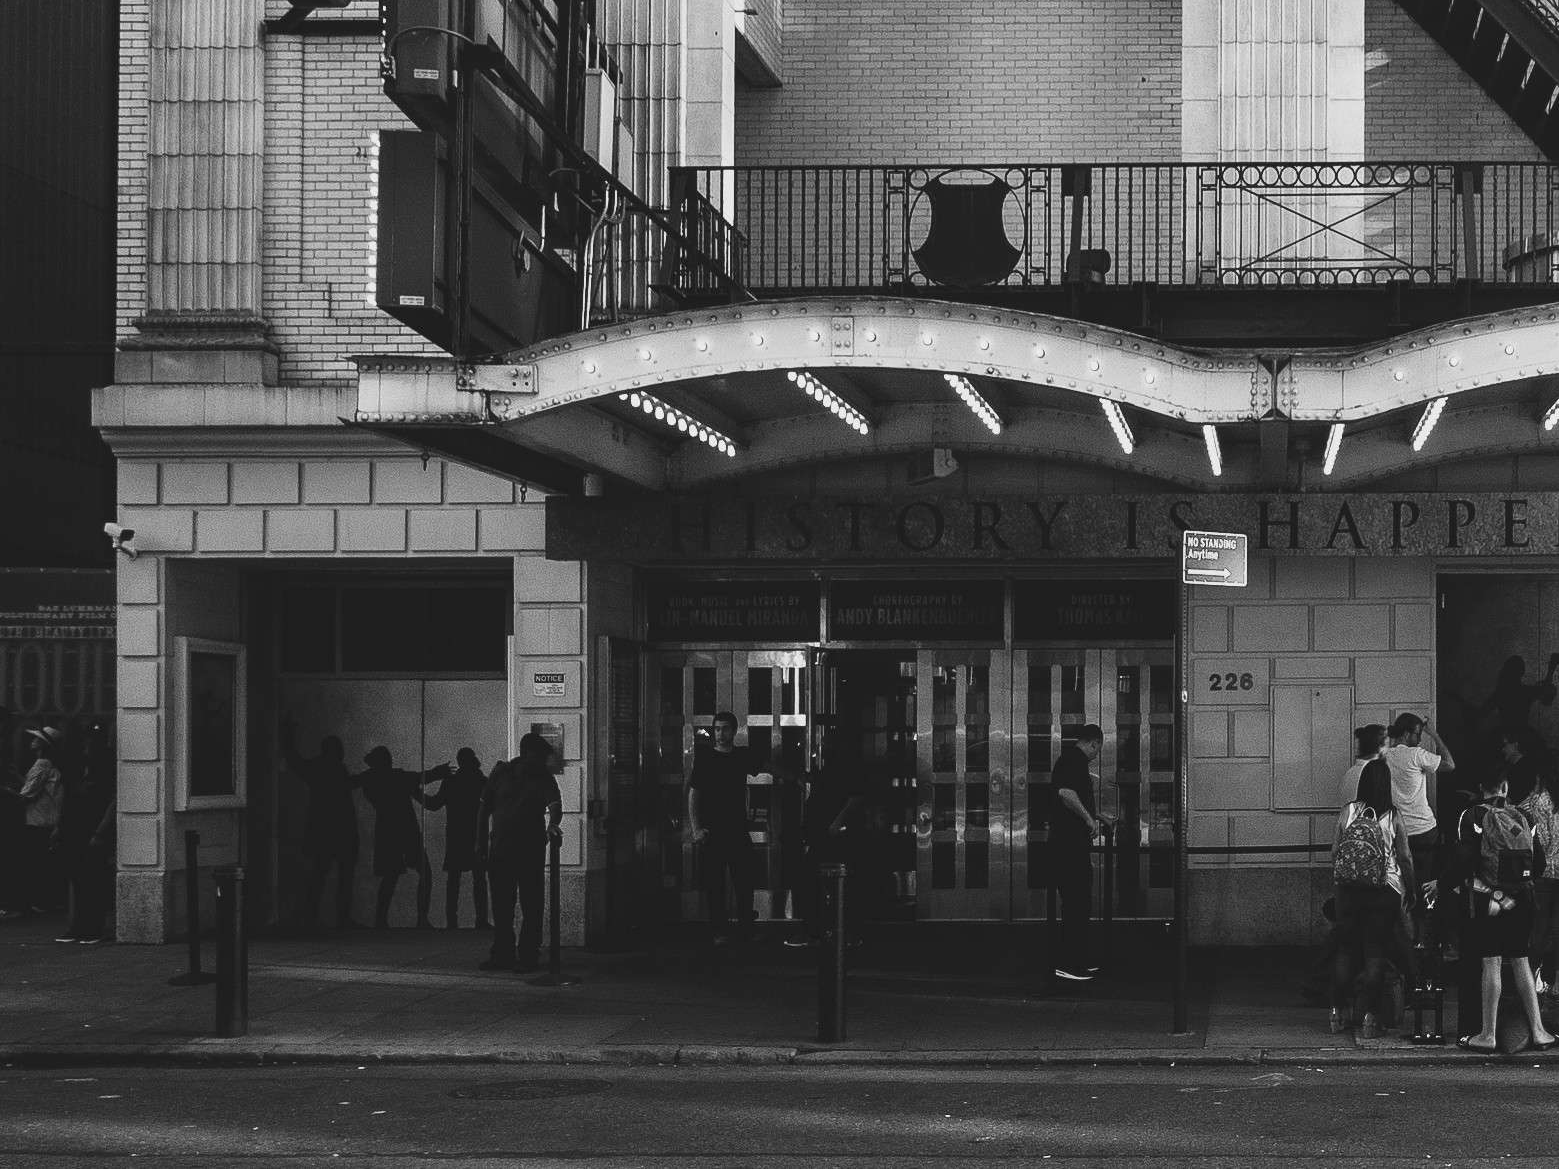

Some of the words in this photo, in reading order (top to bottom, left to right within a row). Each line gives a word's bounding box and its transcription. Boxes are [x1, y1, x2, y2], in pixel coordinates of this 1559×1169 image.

[672, 500, 1064, 551] HISTORY
[1122, 500, 1194, 550] IS
[1187, 537, 1199, 547] NO
[1200, 538, 1237, 549] STANDING
[1187, 548, 1219, 560] Anytime
[873, 594, 946, 607] CHOREOGRAPHY
[747, 608, 809, 627] MIRANDA
[837, 607, 872, 626] ANDY
[1208, 672, 1254, 692] 226
